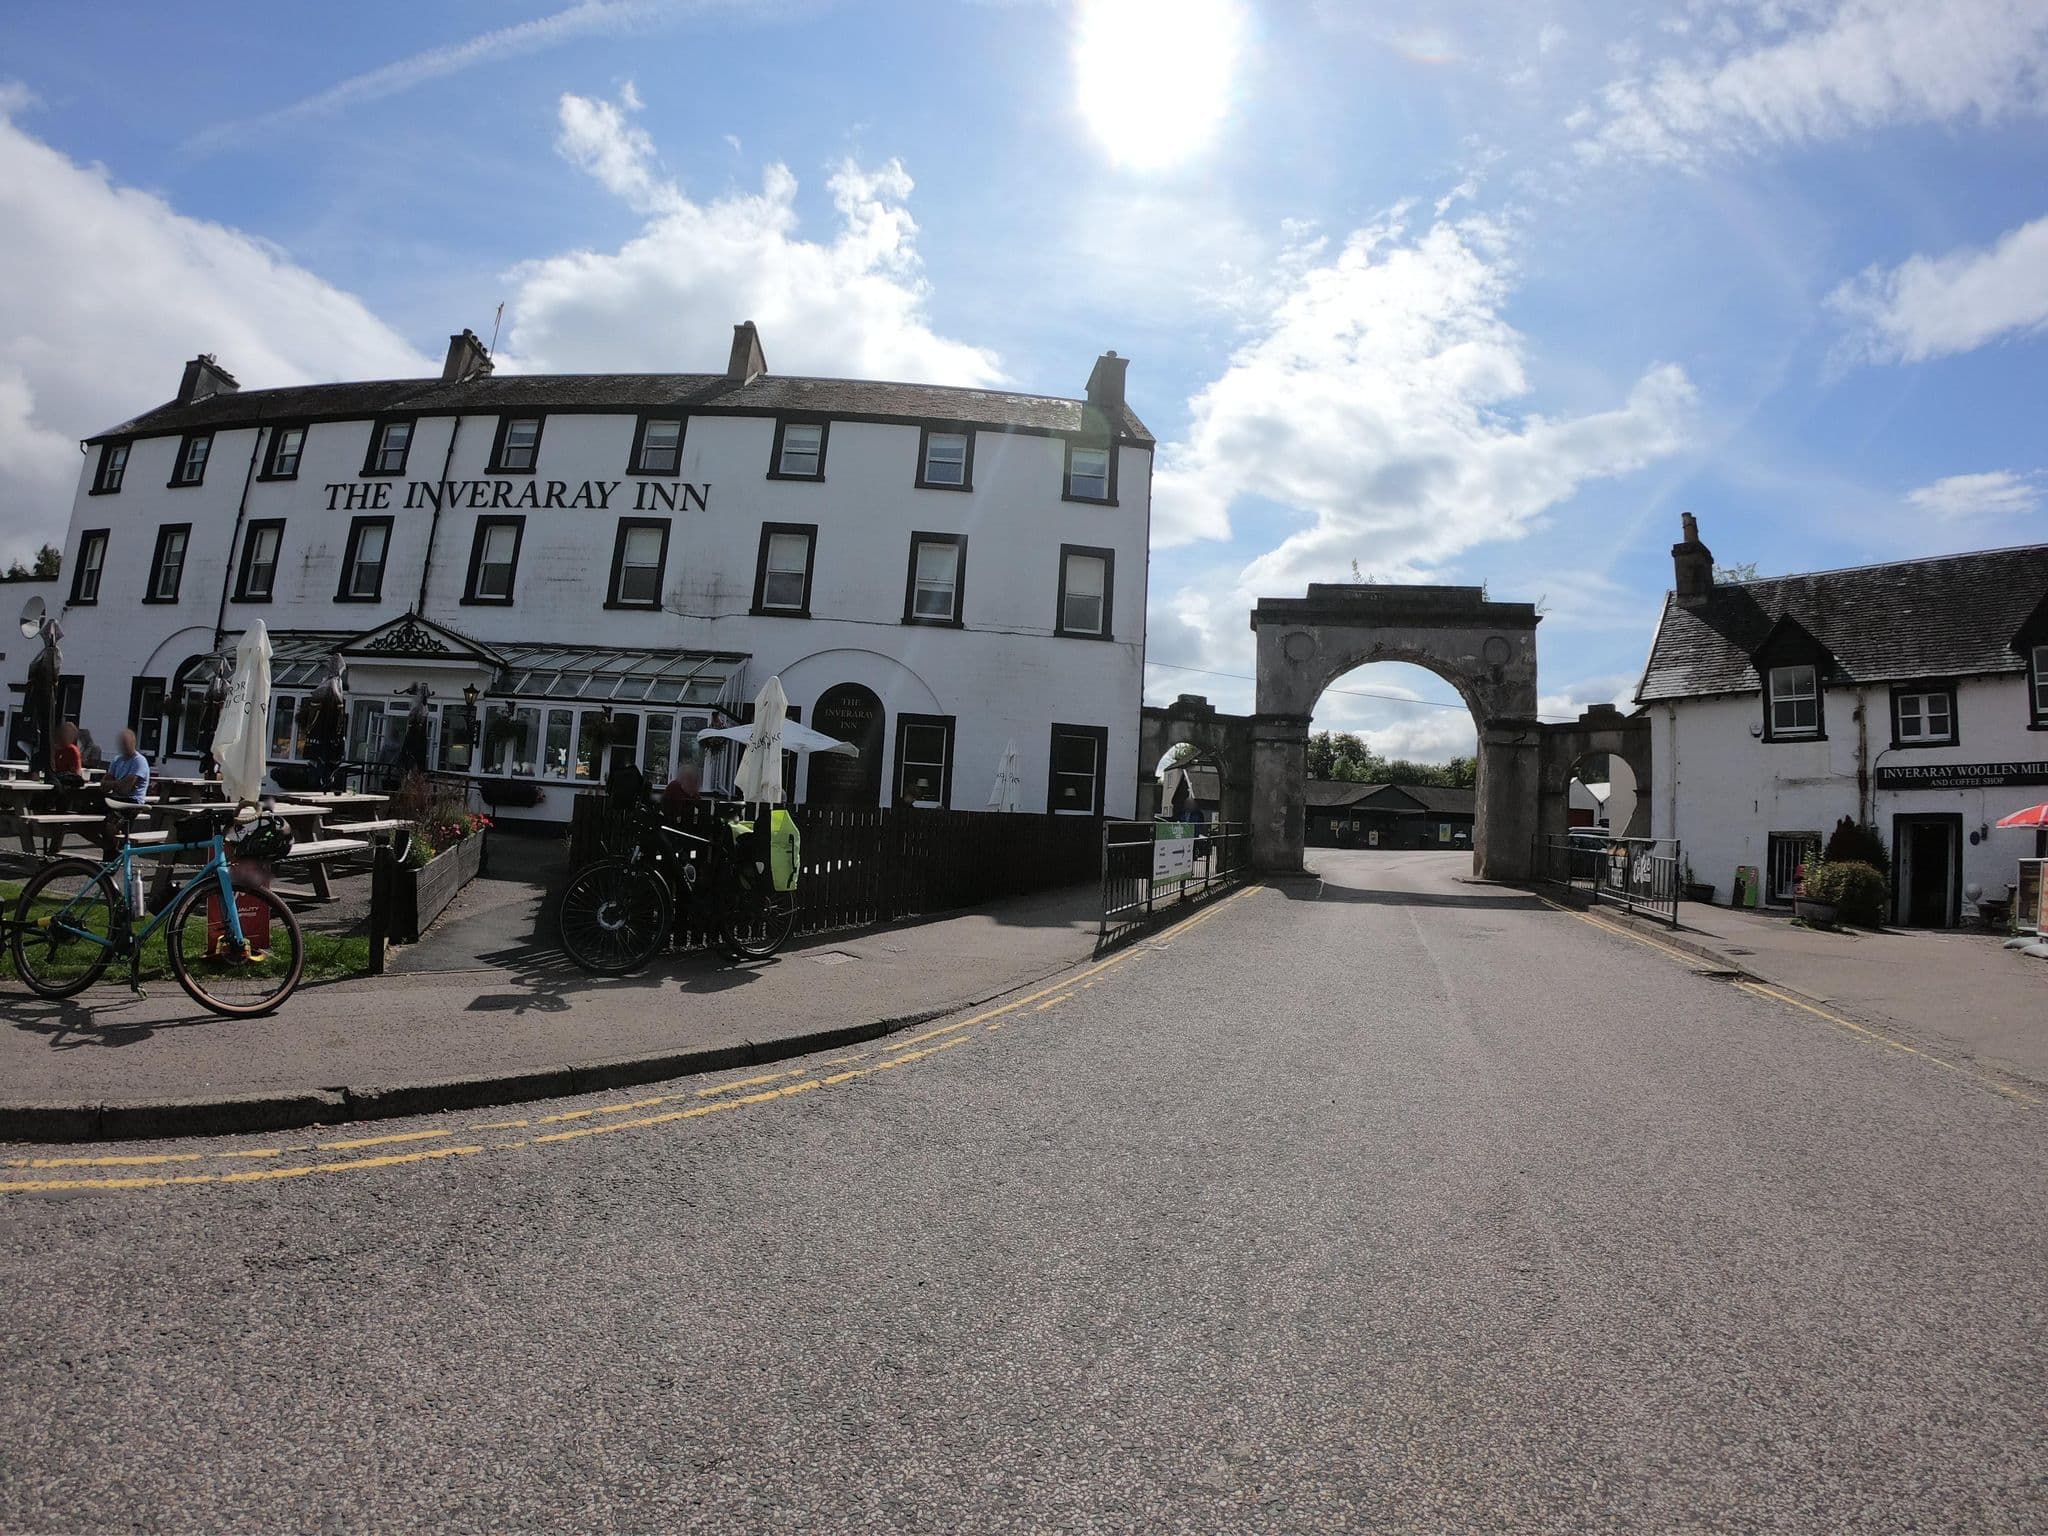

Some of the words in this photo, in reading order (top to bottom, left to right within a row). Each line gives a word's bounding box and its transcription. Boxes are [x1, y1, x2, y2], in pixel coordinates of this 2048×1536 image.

[325, 482, 391, 511] THE
[403, 480, 621, 510] INVERARAY
[632, 482, 711, 512] INN
[841, 697, 862, 706] THE
[826, 710, 873, 719] INVERARAY
[841, 720, 857, 729] INN
[1884, 767, 1953, 779] INVERARAY
[1957, 763, 2017, 777] WOOLLEN
[1930, 779, 1947, 787] AND
[1949, 778, 1981, 786] COFFEE
[1982, 777, 2005, 785] SHOP
